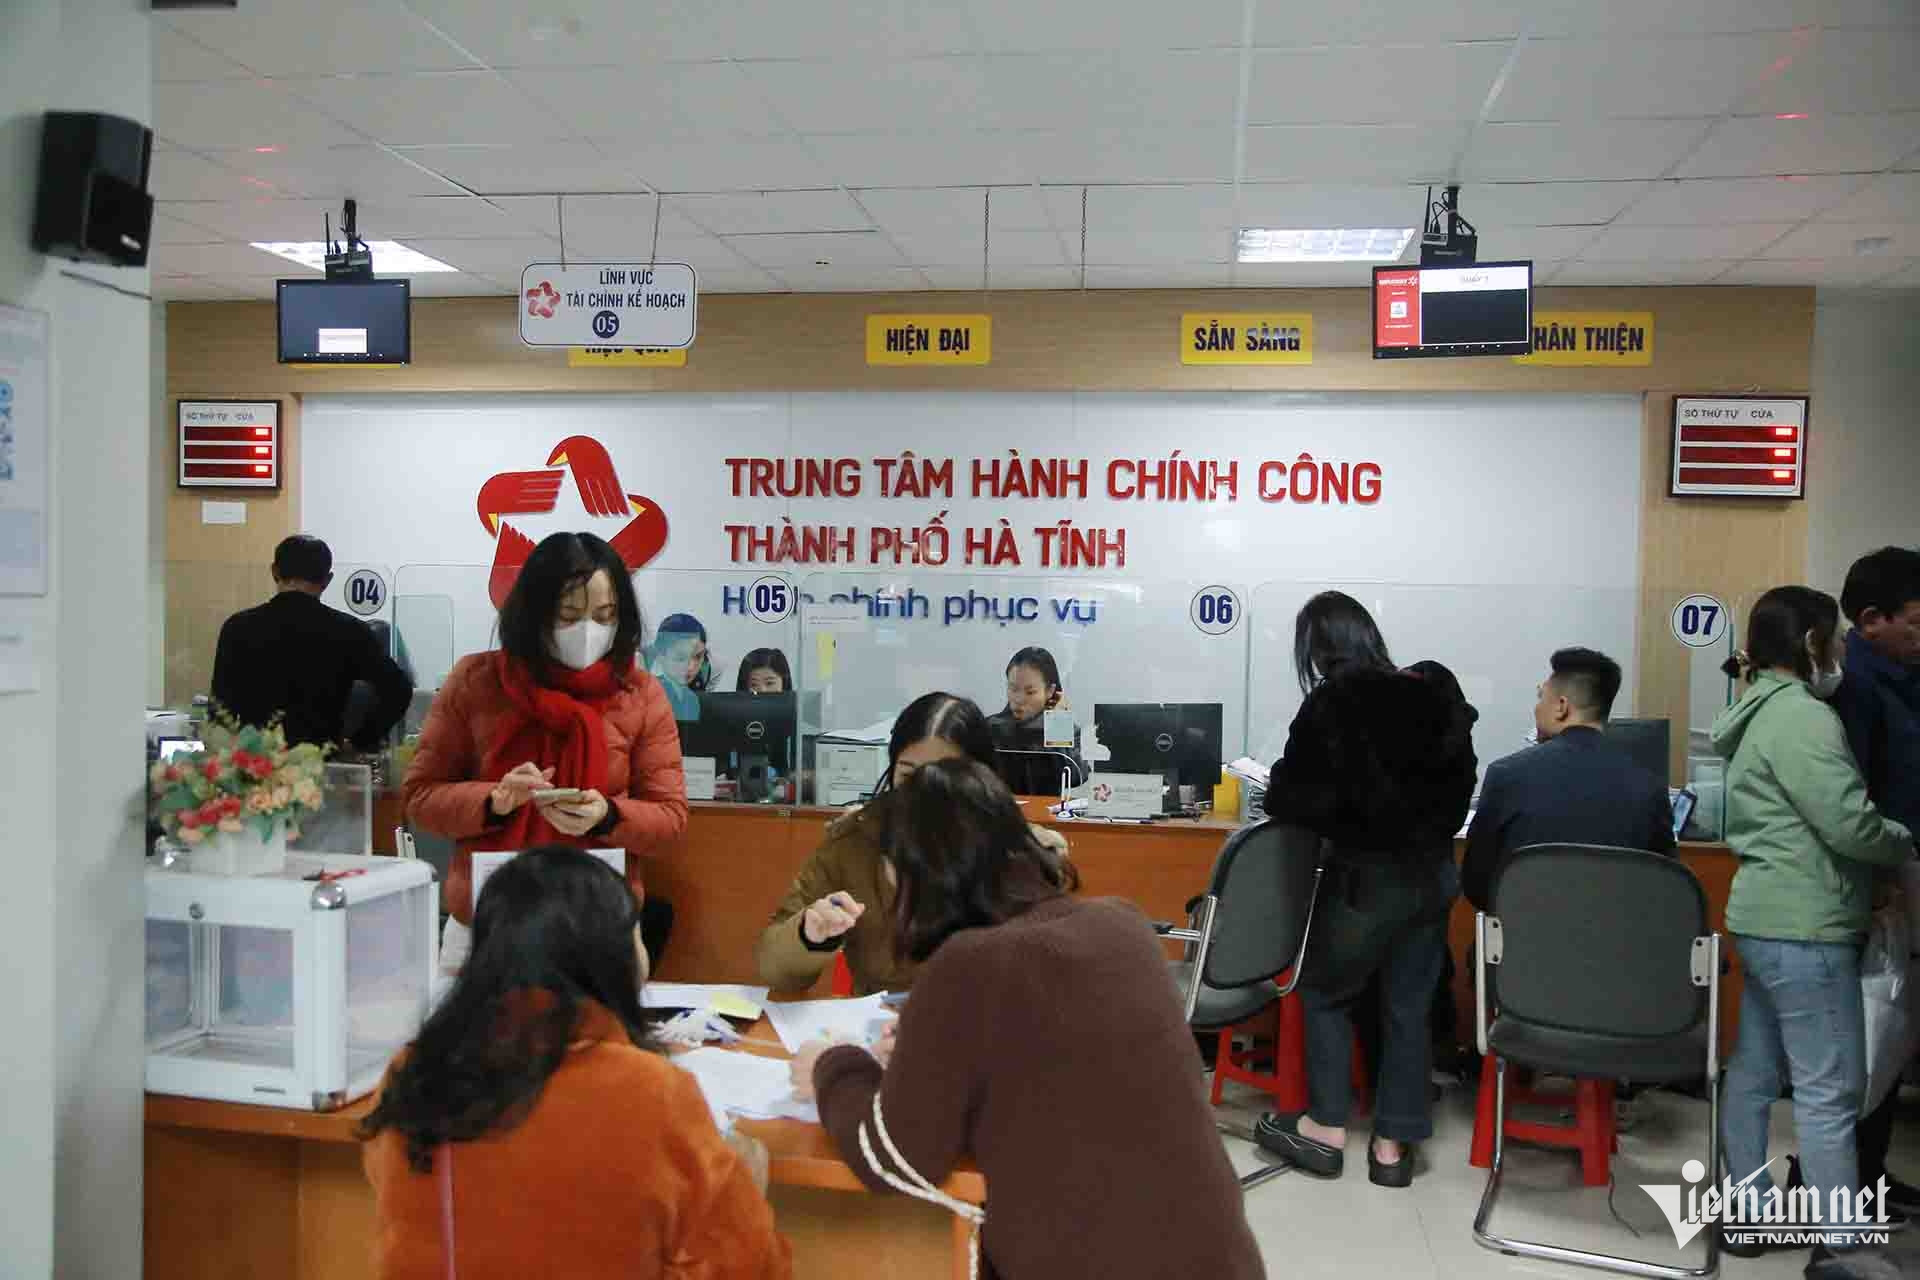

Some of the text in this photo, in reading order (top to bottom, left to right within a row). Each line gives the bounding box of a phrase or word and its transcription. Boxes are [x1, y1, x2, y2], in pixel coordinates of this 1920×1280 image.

[600, 268, 653, 287] LĨNH VỰC
[567, 290, 584, 308] TÀI
[628, 287, 642, 308] KẾ
[646, 293, 685, 311] HOẠCH
[596, 315, 617, 333] 05
[886, 323, 970, 355] HIỆN ĐẠI
[1194, 319, 1300, 351] SẴN SÀNG
[1533, 321, 1644, 355] HÂN THIỆN
[725, 448, 1383, 505] TRUNG TÂM HÀNH CHÍNH CÔNG
[724, 510, 1127, 568] THÀNH PHỐ HÀ TĨNH
[351, 578, 380, 605] 04
[755, 585, 786, 613] 05
[944, 589, 1039, 628] phục
[1051, 598, 1097, 627] vụ
[1200, 594, 1233, 624] 06
[1682, 605, 1719, 635] 07
